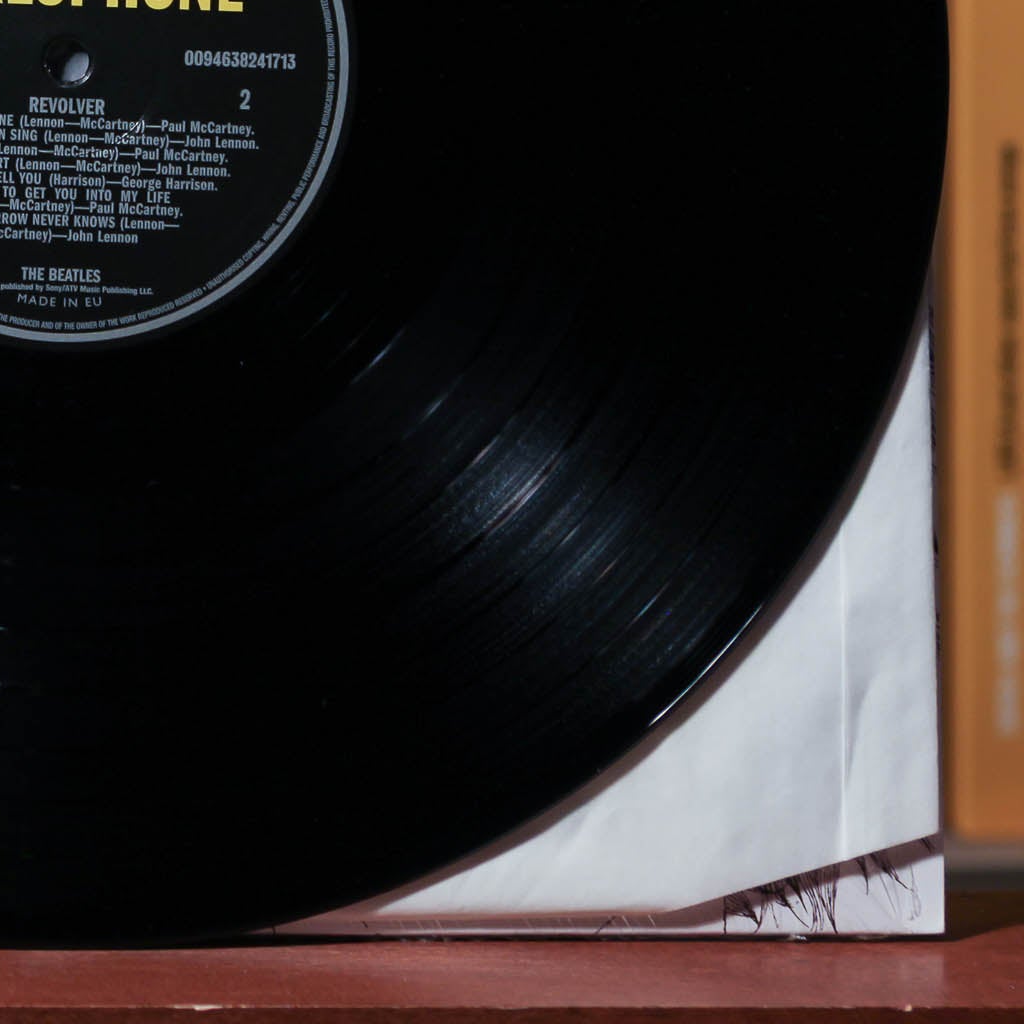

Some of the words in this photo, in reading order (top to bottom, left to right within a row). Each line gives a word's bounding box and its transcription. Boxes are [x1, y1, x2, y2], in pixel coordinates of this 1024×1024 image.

[184, 50, 296, 70] 0094638241713
[29, 96, 105, 115] REVOLVER
[239, 88, 251, 110] 2
[190, 120, 255, 137] McCartney.
[10, 128, 38, 142] SING
[215, 136, 259, 150] Lennon.
[163, 149, 229, 165] McCartney.
[186, 164, 231, 177] Lennon.
[19, 172, 42, 185] YOU
[165, 177, 218, 191] Harrison.
[2, 185, 17, 198] TO
[25, 186, 47, 199] GET
[54, 187, 78, 200] YOU
[85, 188, 113, 201] INTO
[120, 190, 139, 203] MY
[146, 191, 171, 204] LIFE
[118, 202, 183, 219] McCartney.
[32, 213, 69, 227] NEVER
[73, 215, 116, 229] KNOWS
[97, 230, 139, 244] Lennon
[21, 266, 45, 281] THE
[48, 267, 101, 283] BEATLES
[0, 283, 33, 291] published
[35, 284, 44, 292] by
[79, 285, 101, 293] Music
[102, 286, 138, 296] Publishing
[17, 293, 57, 307] MADE
[63, 297, 78, 308] IN
[85, 297, 102, 308] EU
